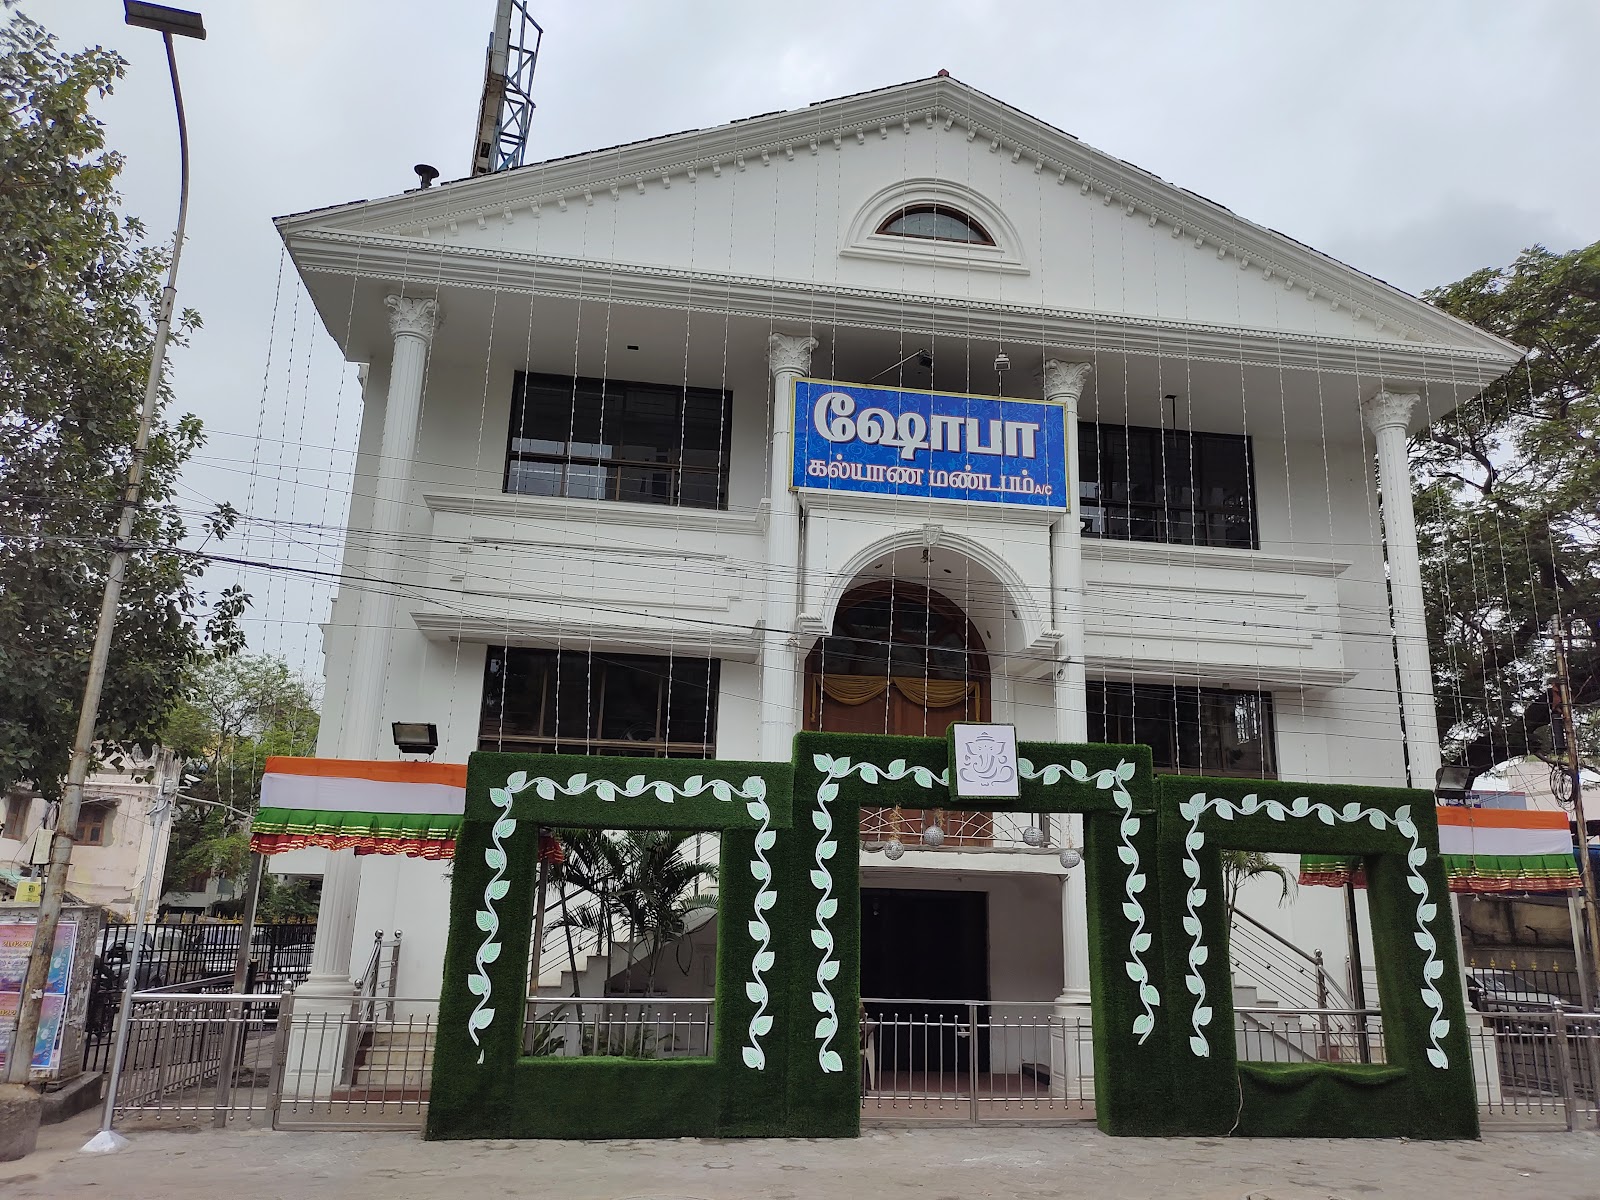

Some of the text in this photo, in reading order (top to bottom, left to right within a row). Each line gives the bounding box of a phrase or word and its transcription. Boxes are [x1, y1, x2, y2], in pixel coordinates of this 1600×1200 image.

[814, 392, 1040, 460] ஷோபா
[808, 453, 1034, 494] கல்யாண மண்டபம்
[1034, 484, 1052, 495] A/C
